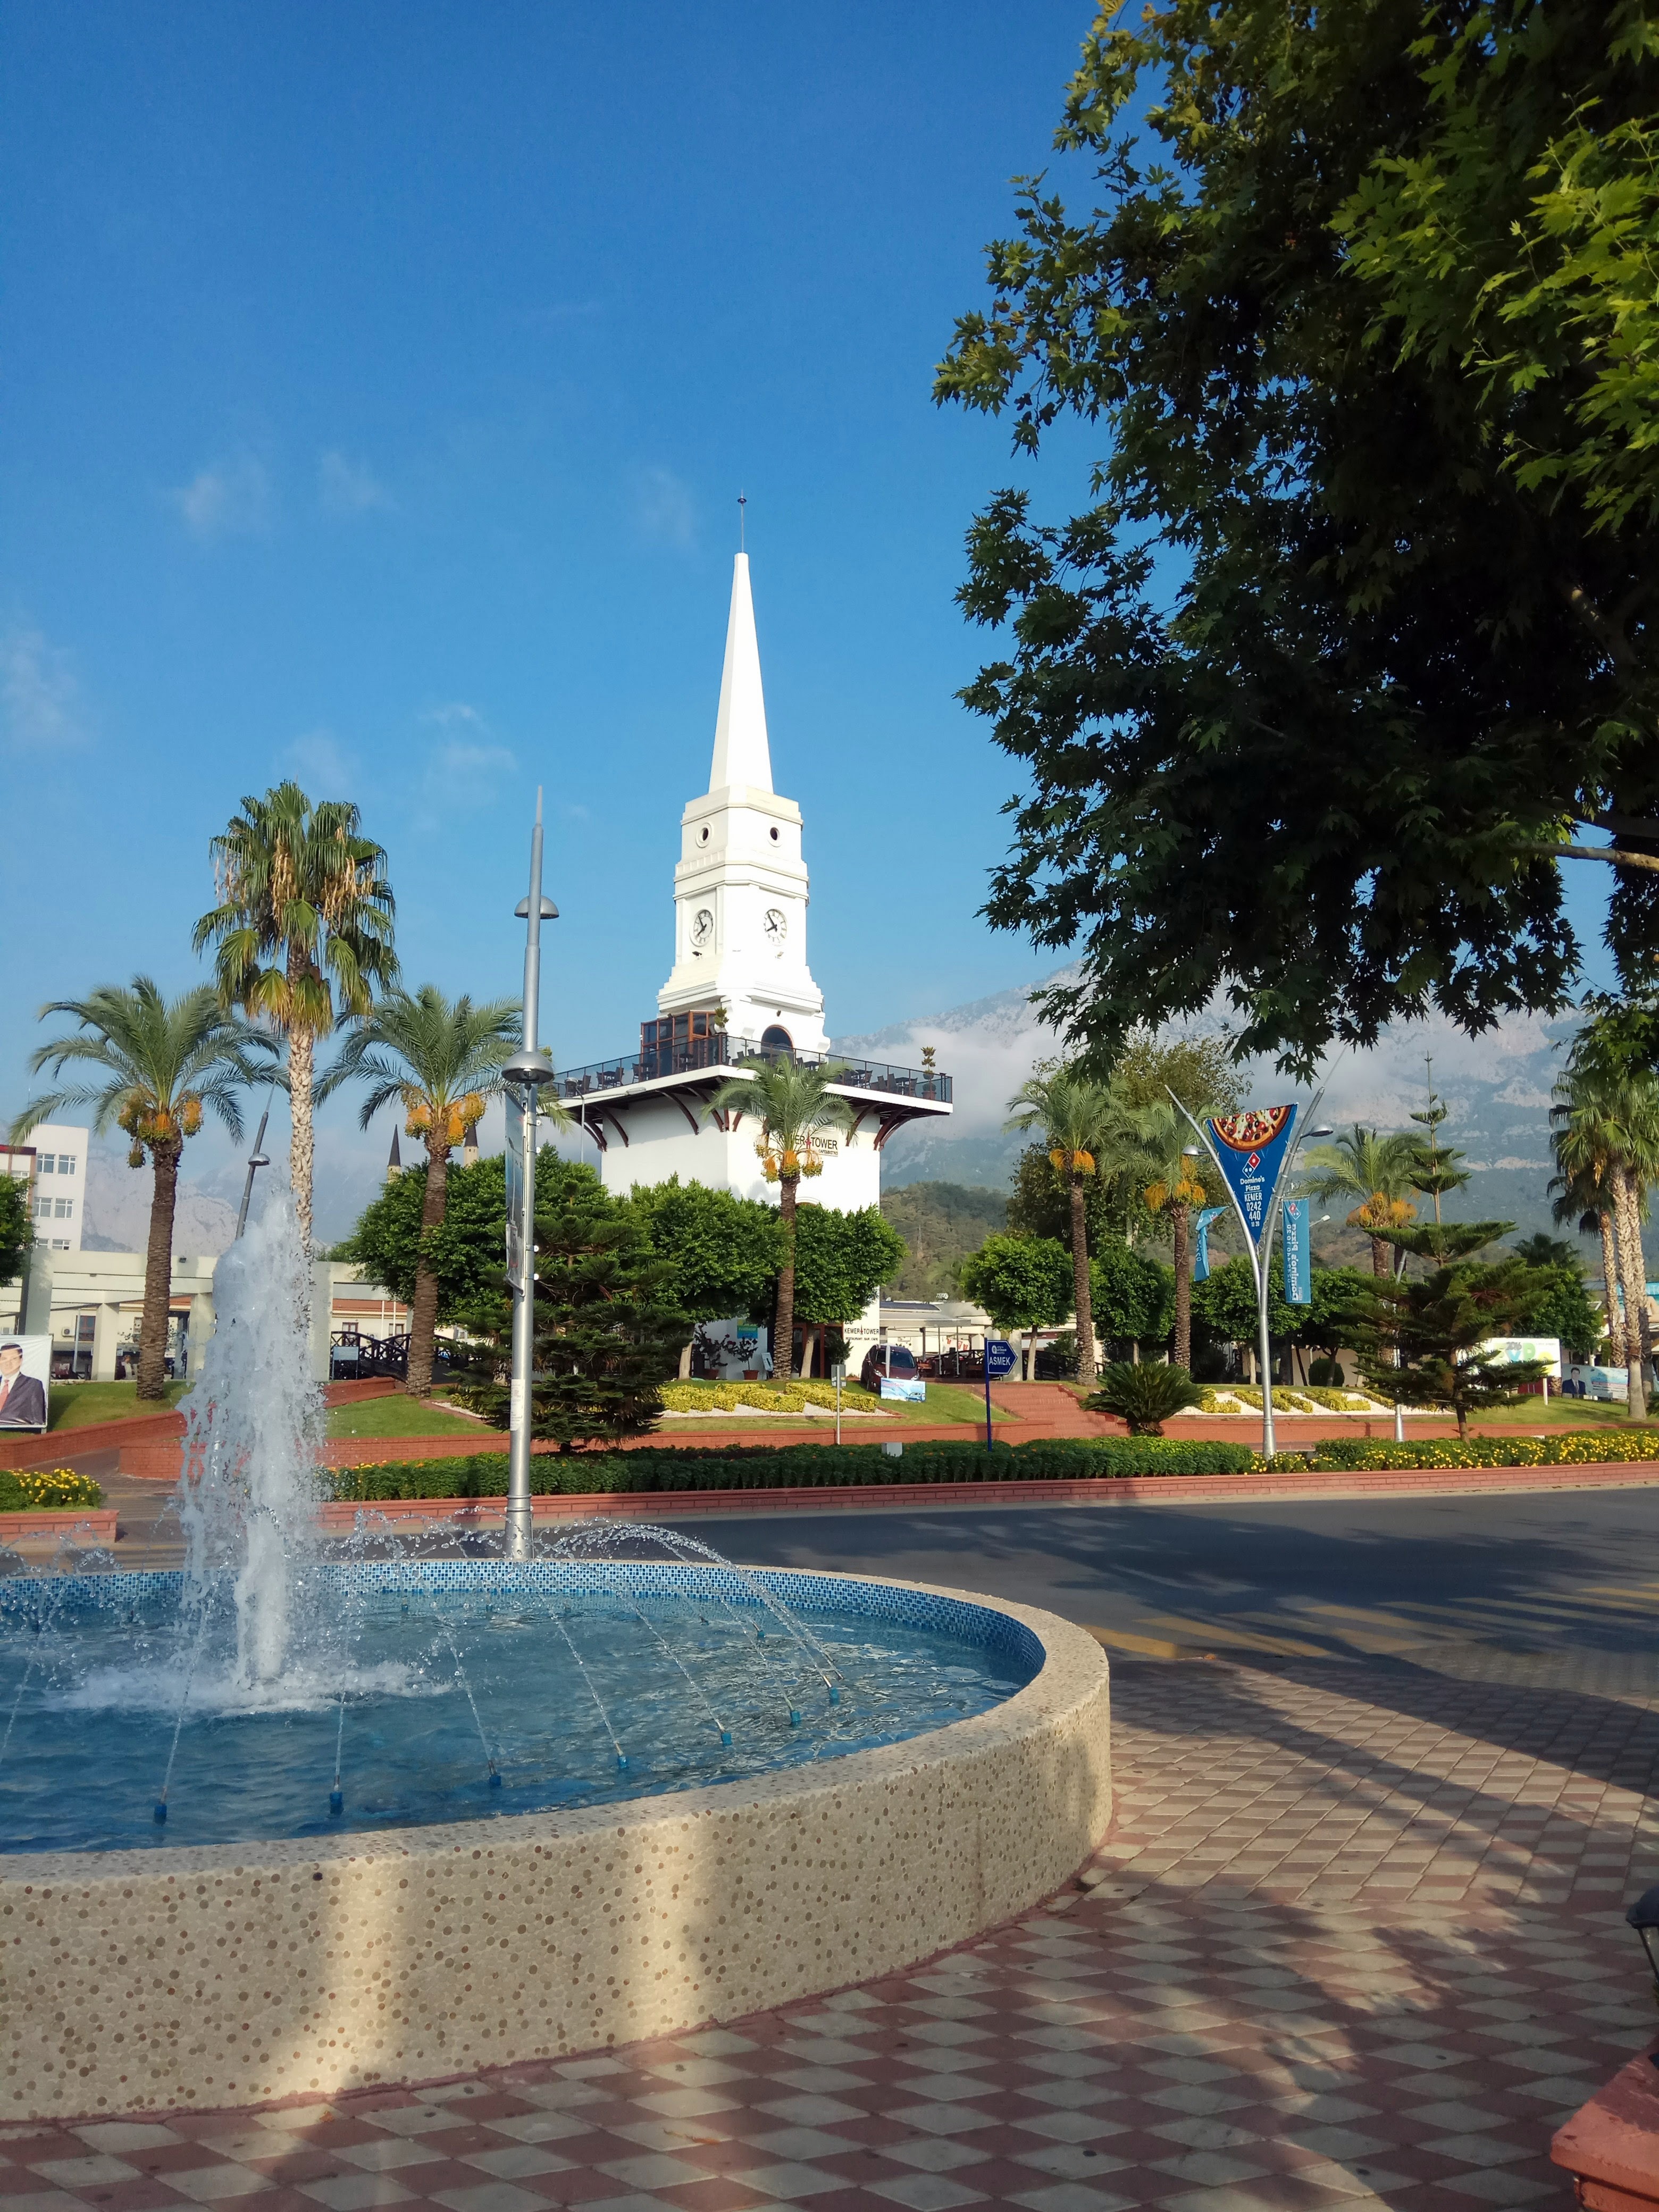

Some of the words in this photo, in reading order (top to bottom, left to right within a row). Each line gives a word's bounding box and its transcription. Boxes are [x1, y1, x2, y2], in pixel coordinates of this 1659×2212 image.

[811, 1137, 838, 1150] TOWER
[1240, 1175, 1266, 1185] Domino's
[1244, 1192, 1262, 1202] KEMER
[1246, 1201, 1262, 1212] 0242
[1249, 1210, 1261, 1221] 440
[1506, 1341, 1521, 1351] 2016
[989, 1357, 1010, 1366] ASMEK
